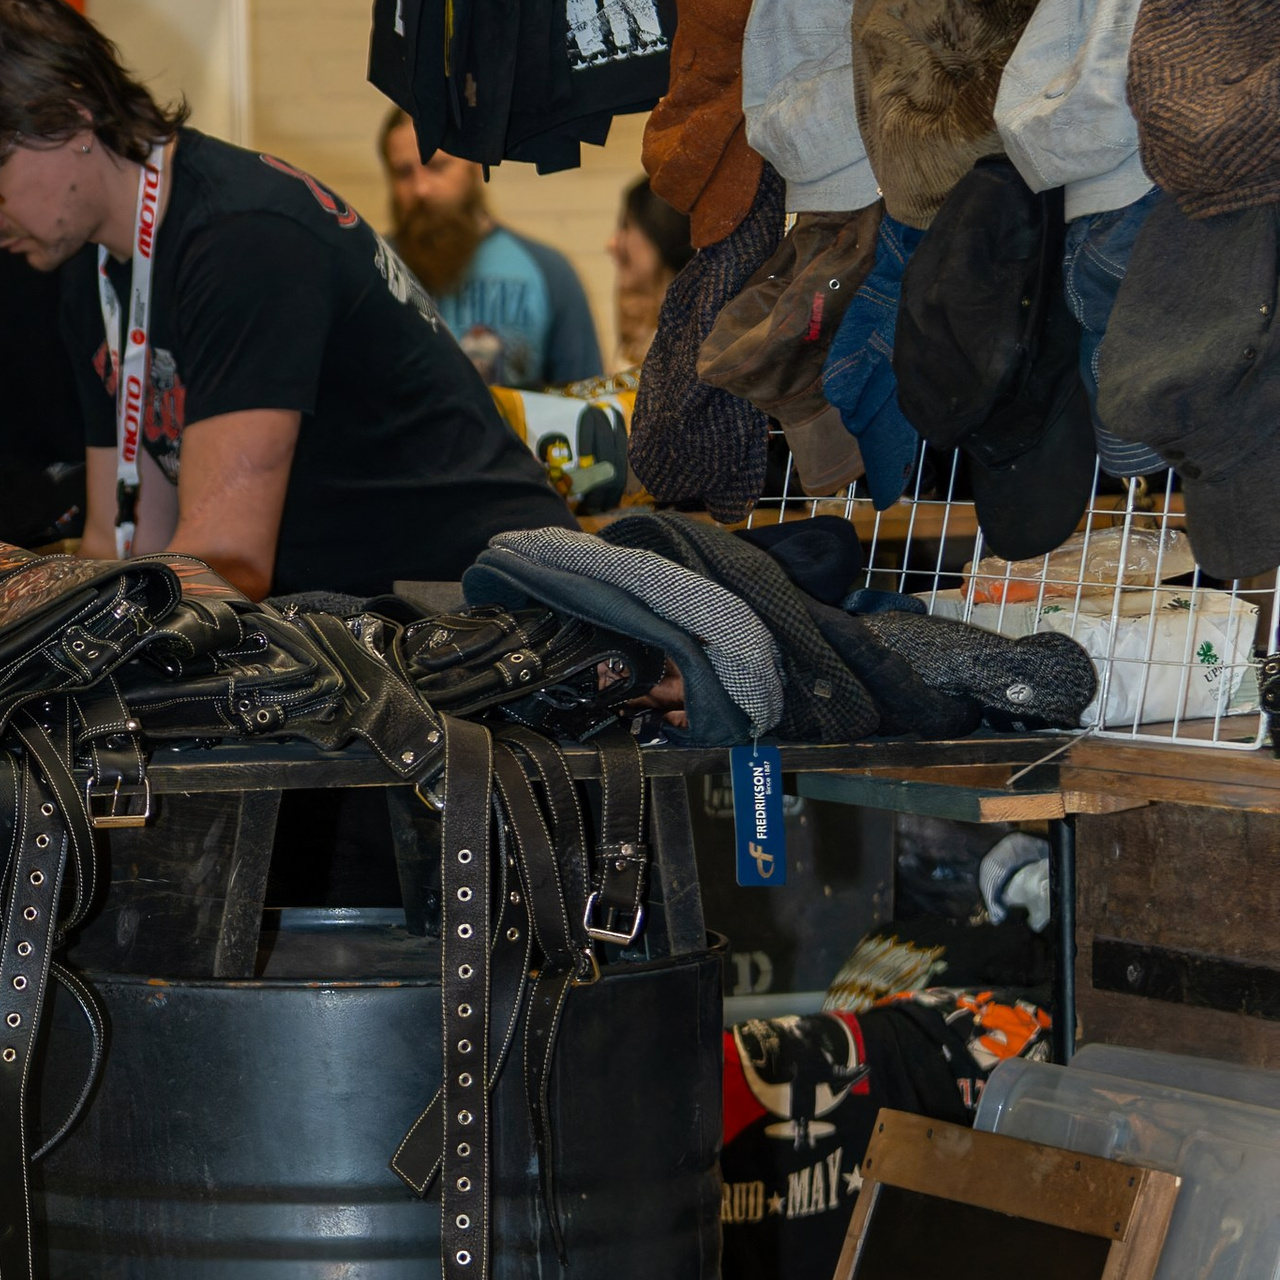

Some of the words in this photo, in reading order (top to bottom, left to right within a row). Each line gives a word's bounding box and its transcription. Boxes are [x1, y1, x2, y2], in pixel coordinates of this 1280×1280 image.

[123, 374, 143, 463] MOTO
[753, 766, 769, 840] FREDRIKSON
[720, 1180, 766, 1224] RUD
[786, 1146, 844, 1219] MAY
